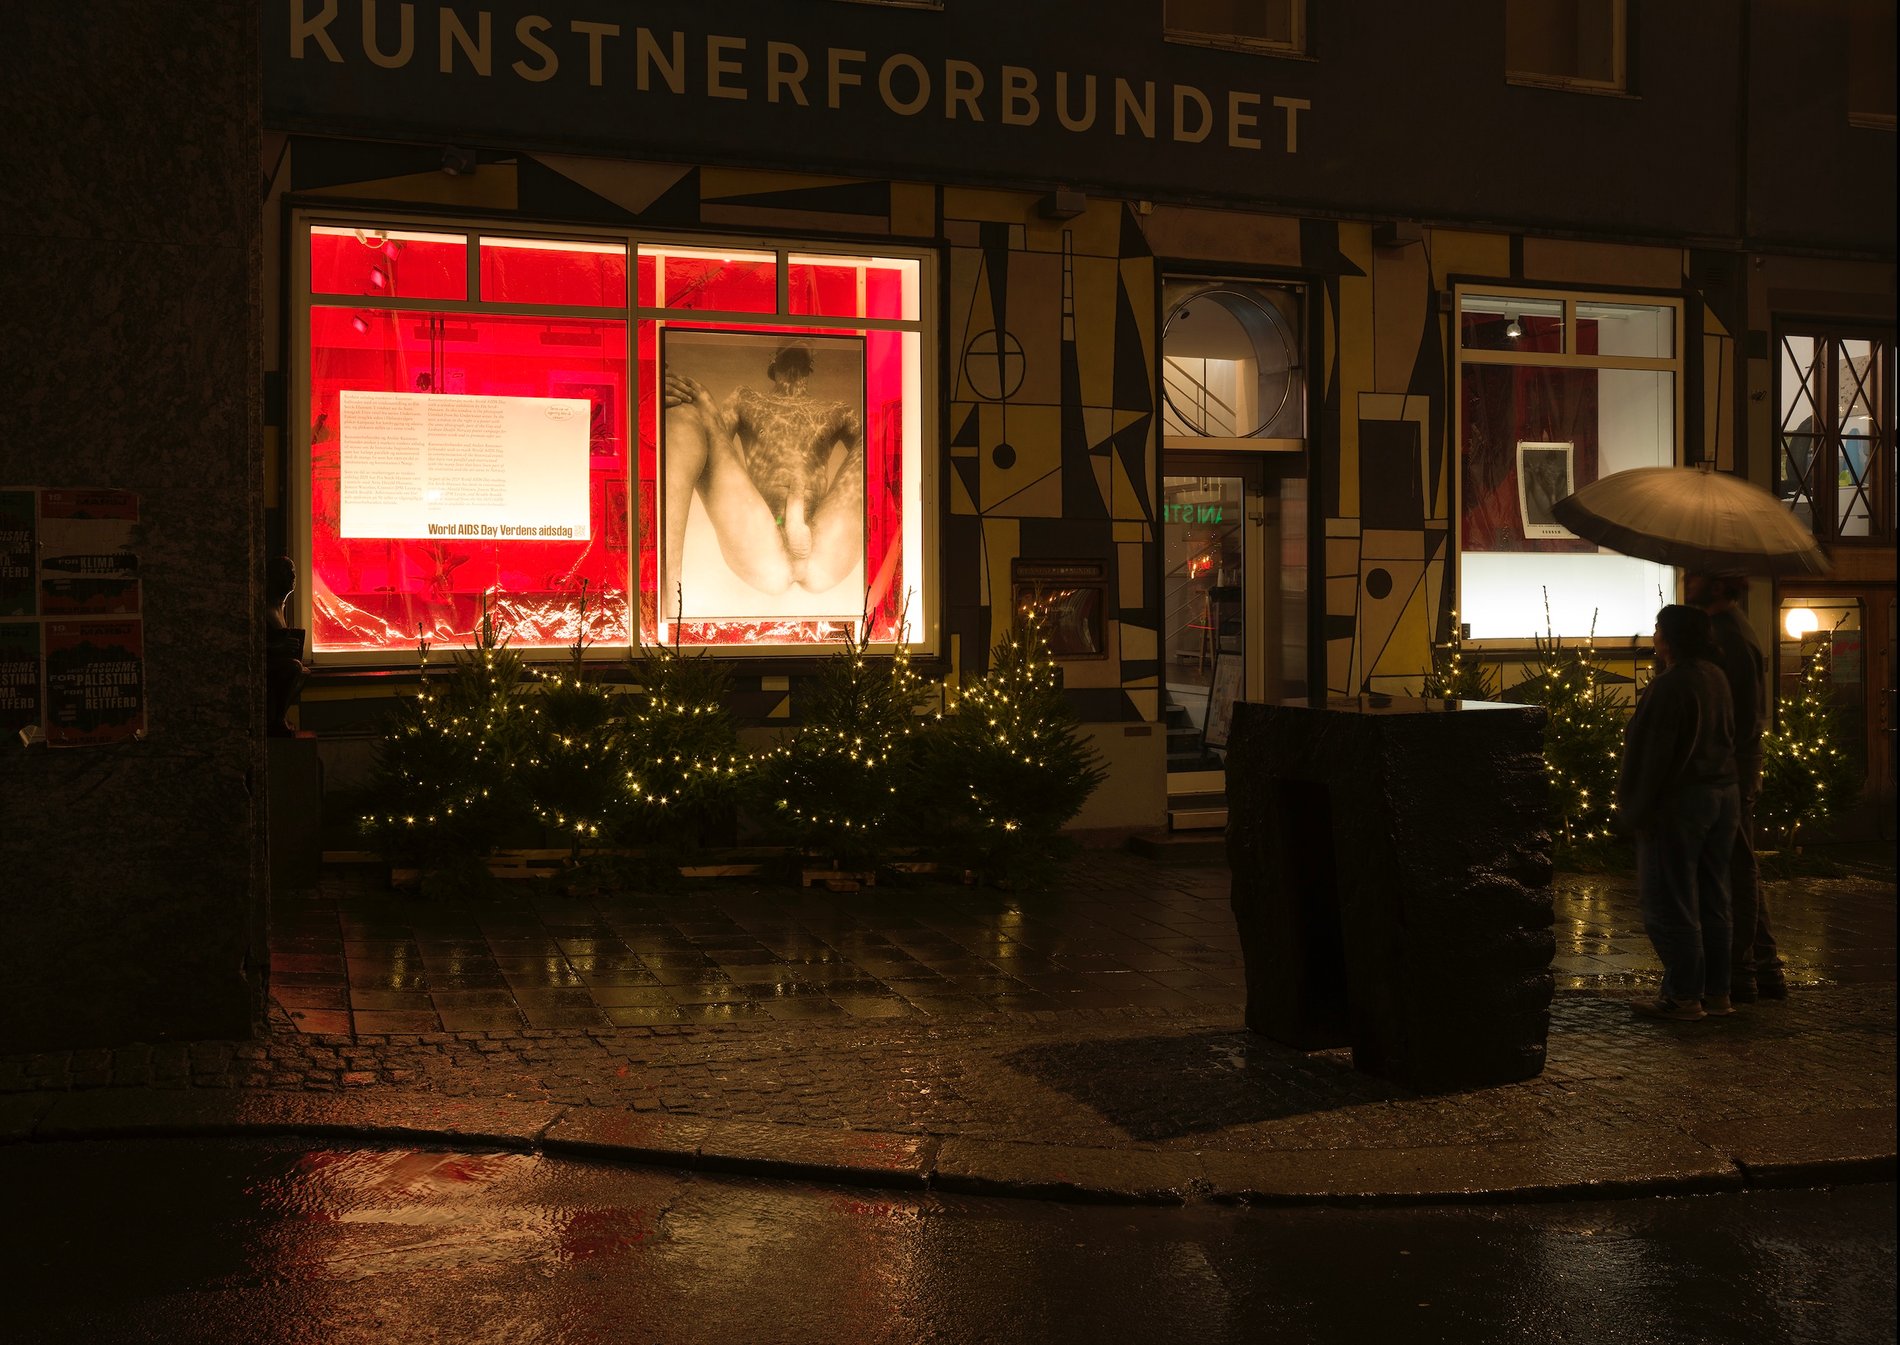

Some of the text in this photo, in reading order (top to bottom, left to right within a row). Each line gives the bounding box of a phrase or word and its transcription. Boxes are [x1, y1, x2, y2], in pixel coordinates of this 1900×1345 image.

[289, 0, 1312, 154] KUNSTNERFORBUNDET
[428, 523, 574, 538] World AIDS Day Verdens aidsdag
[76, 673, 138, 687] PALESTINA
[85, 686, 125, 698] KLIMA-
